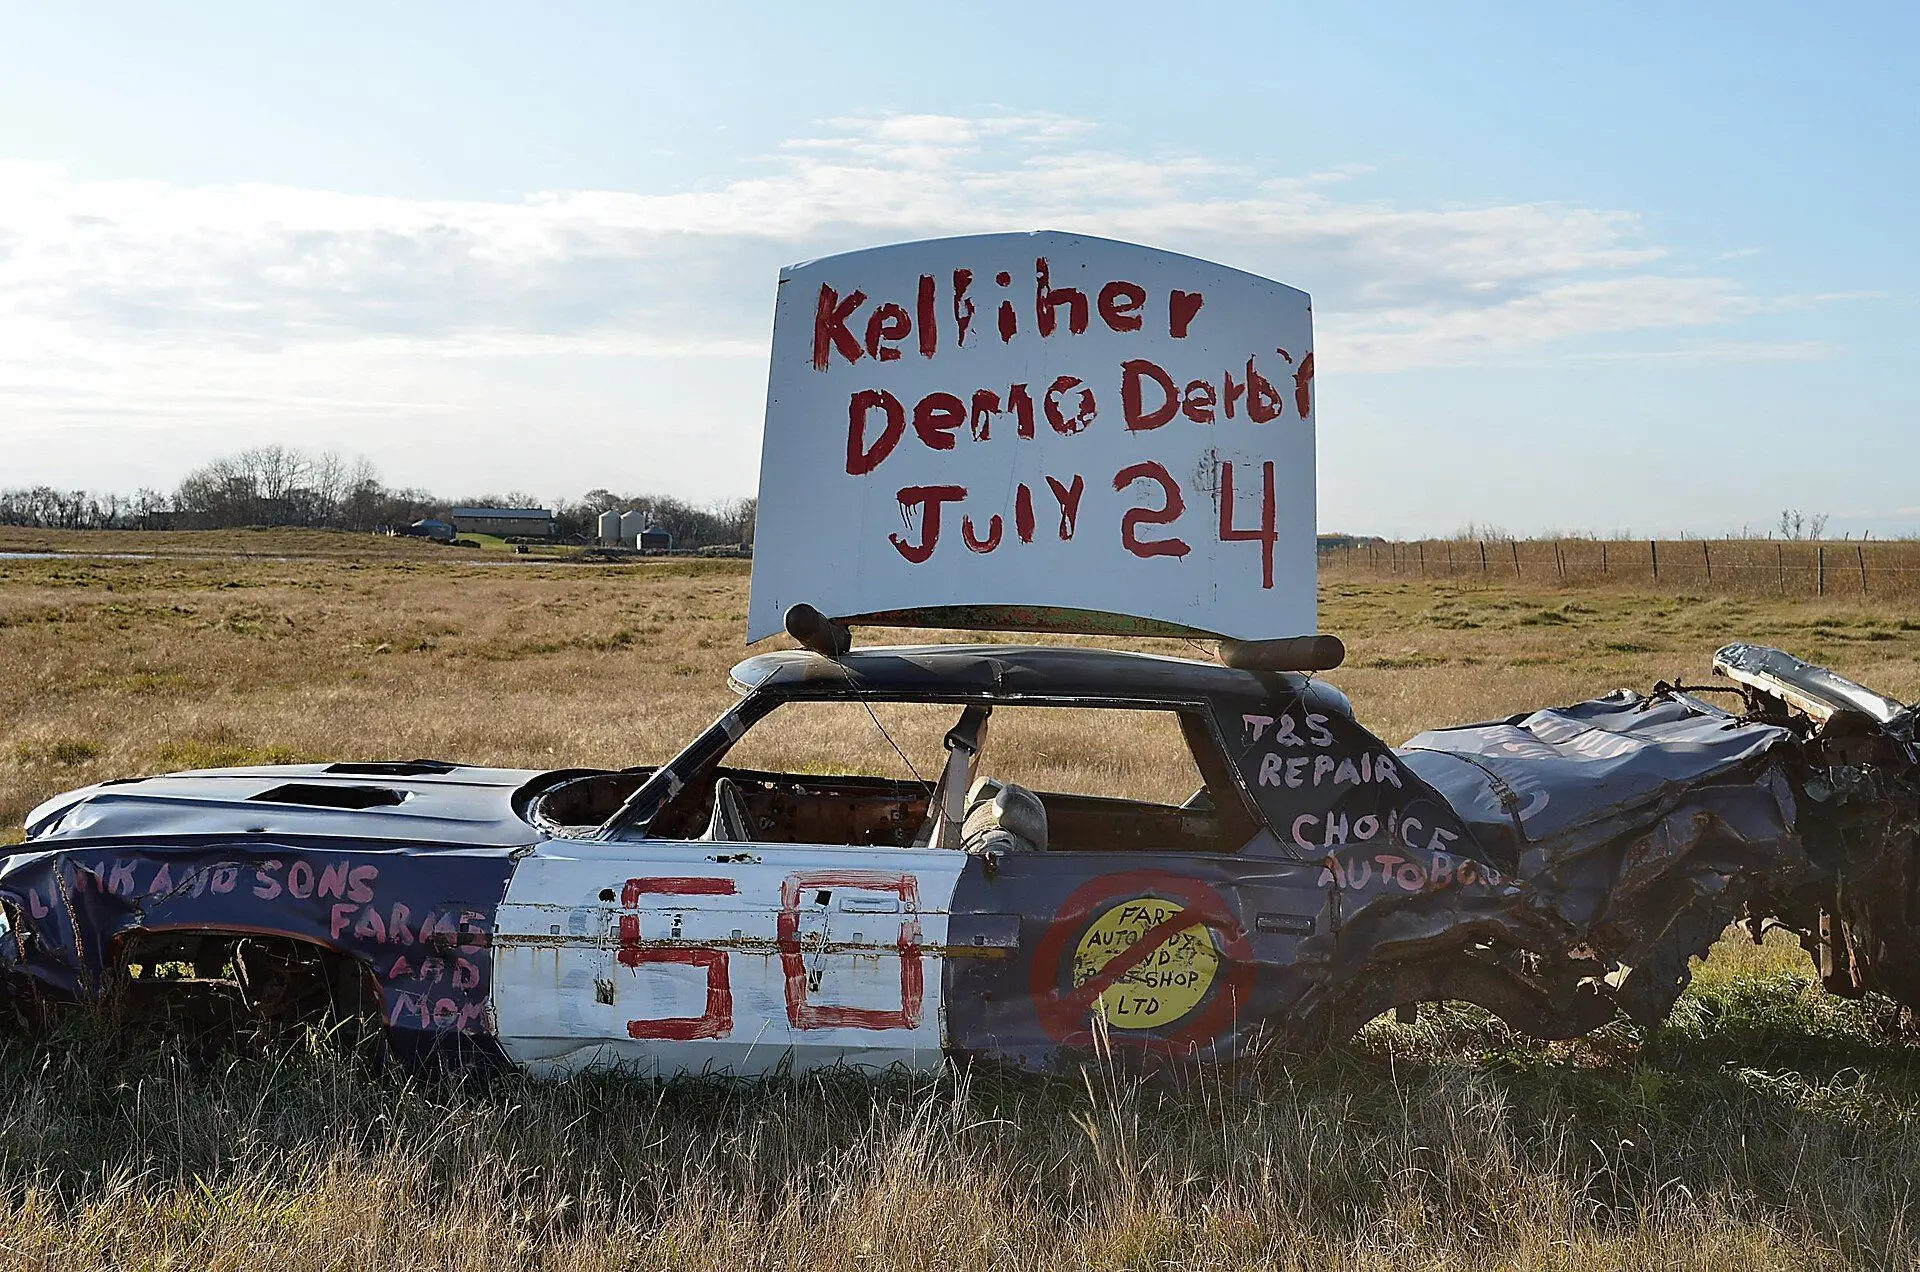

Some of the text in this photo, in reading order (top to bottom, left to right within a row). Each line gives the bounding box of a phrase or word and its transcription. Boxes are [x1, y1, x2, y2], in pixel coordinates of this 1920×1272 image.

[811, 256, 1204, 371] Kelliher
[1111, 459, 1279, 590] 24
[1241, 713, 1337, 747] T&S
[1258, 751, 1403, 789] REPAIR
[1291, 808, 1459, 851] CHOICE
[149, 860, 240, 900] AND
[252, 859, 380, 904] SONS
[1086, 929, 1197, 950] AUTODY
[1144, 971, 1200, 989] SHOP
[1117, 995, 1160, 1015] LTD
